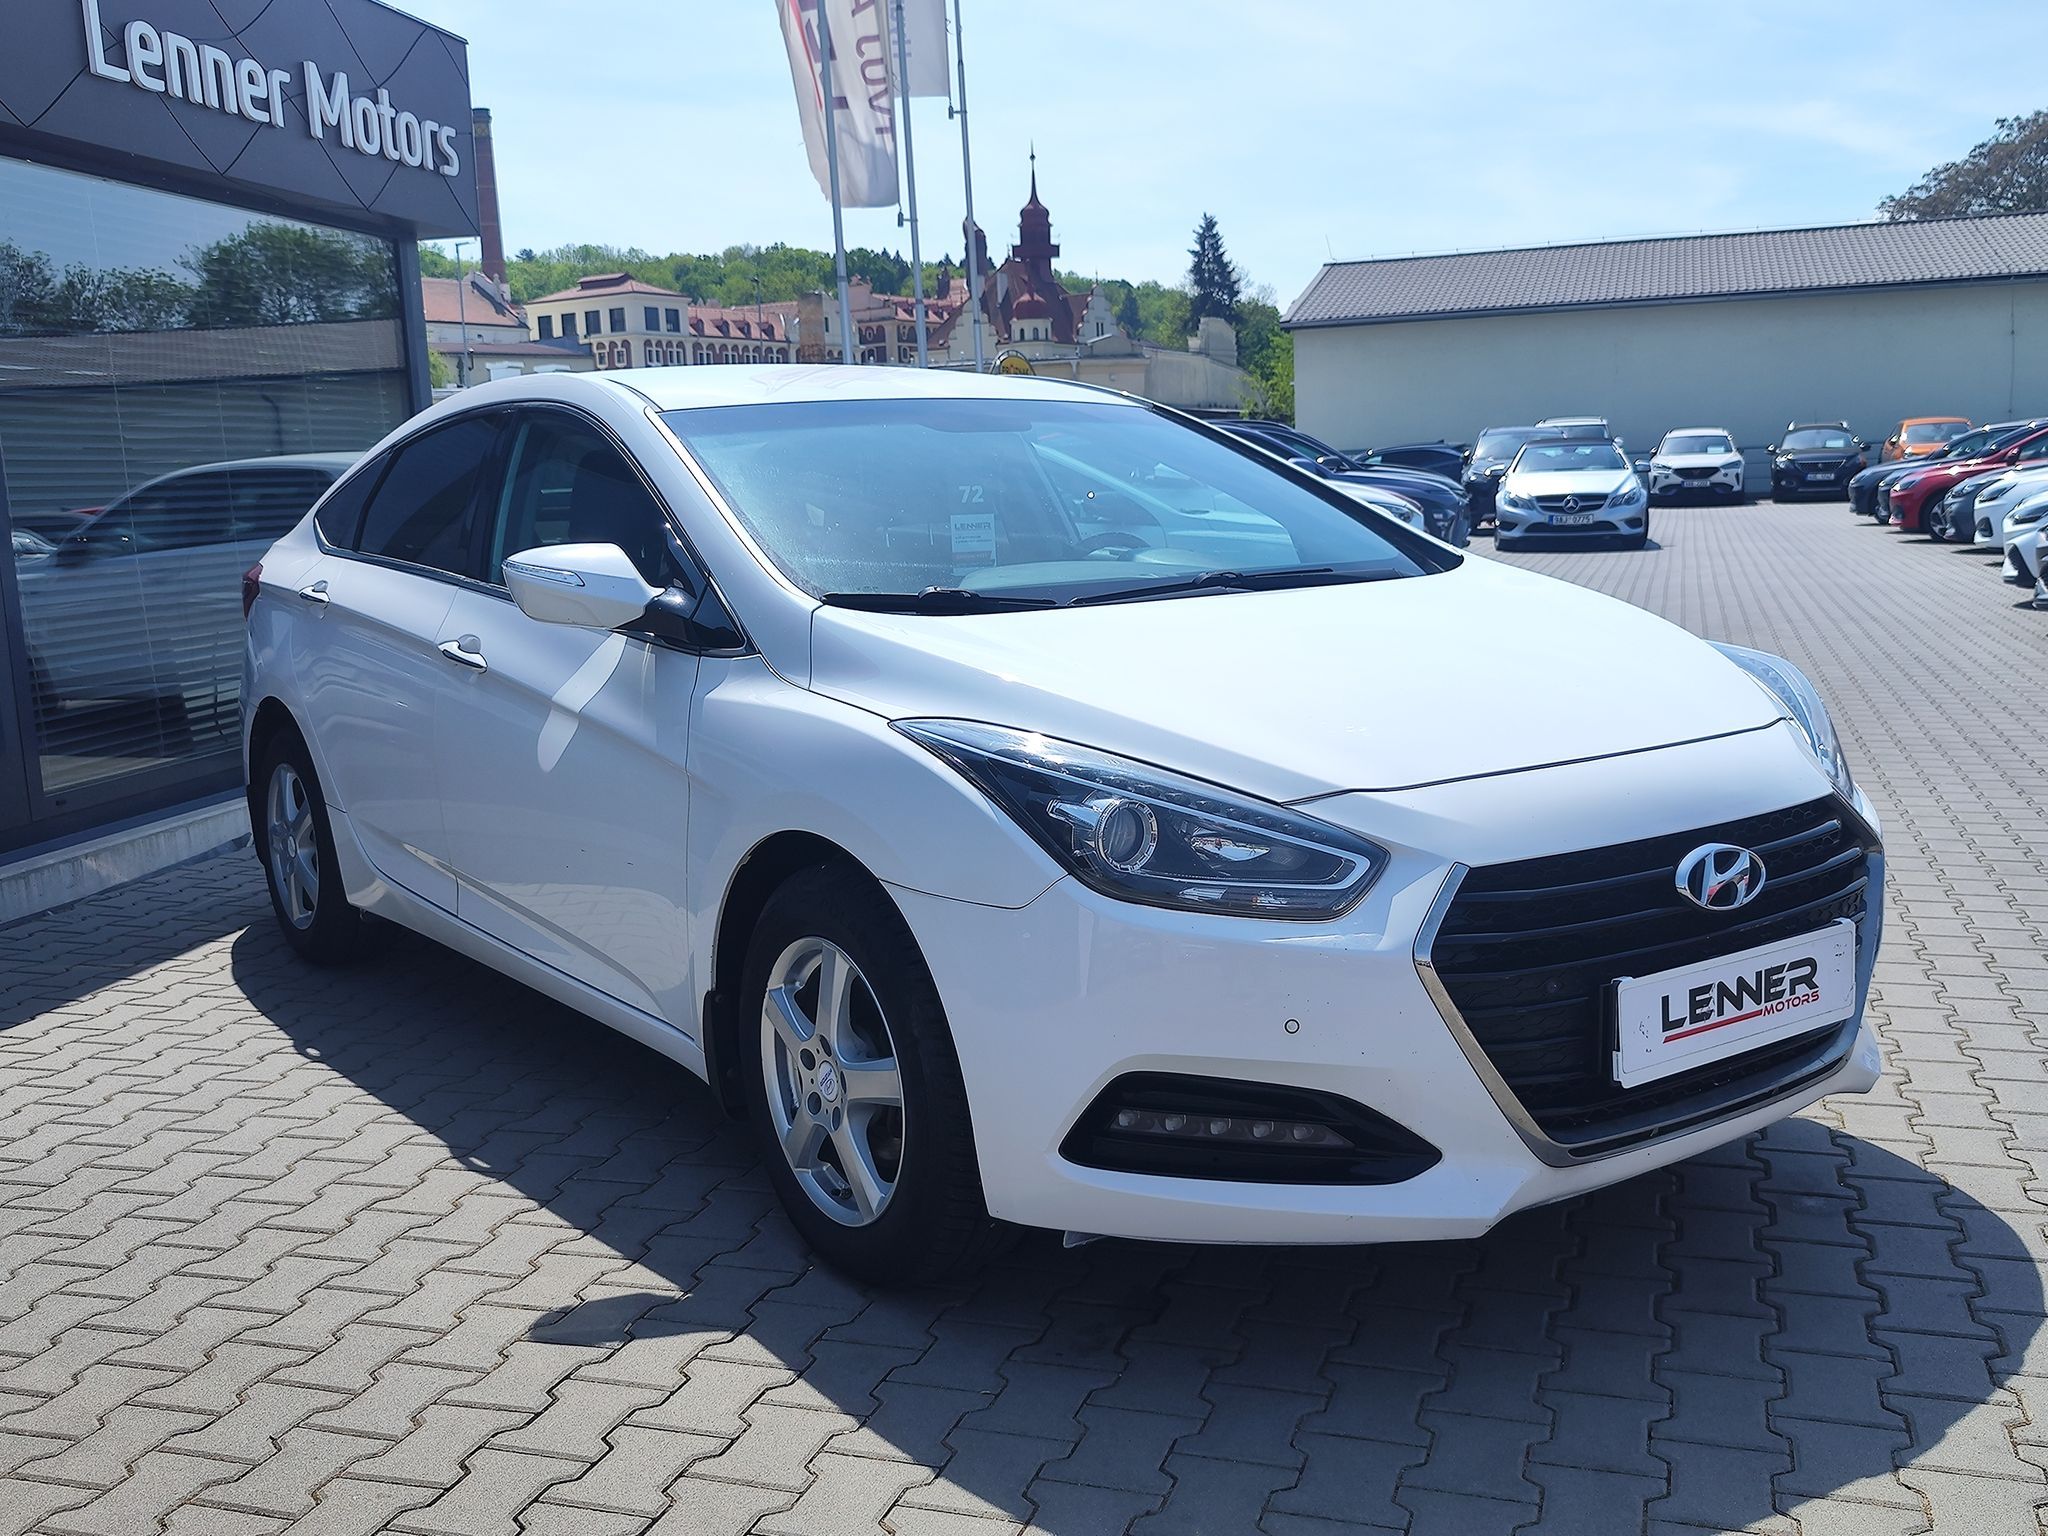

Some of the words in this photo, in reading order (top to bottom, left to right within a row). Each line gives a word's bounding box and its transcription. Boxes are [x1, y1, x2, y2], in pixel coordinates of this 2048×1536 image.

[82, 0, 291, 128] Lenner
[302, 60, 461, 177] Motors
[958, 485, 985, 504] 72
[1661, 956, 1820, 1033] LENNER
[1762, 990, 1820, 1017] MOTORS
